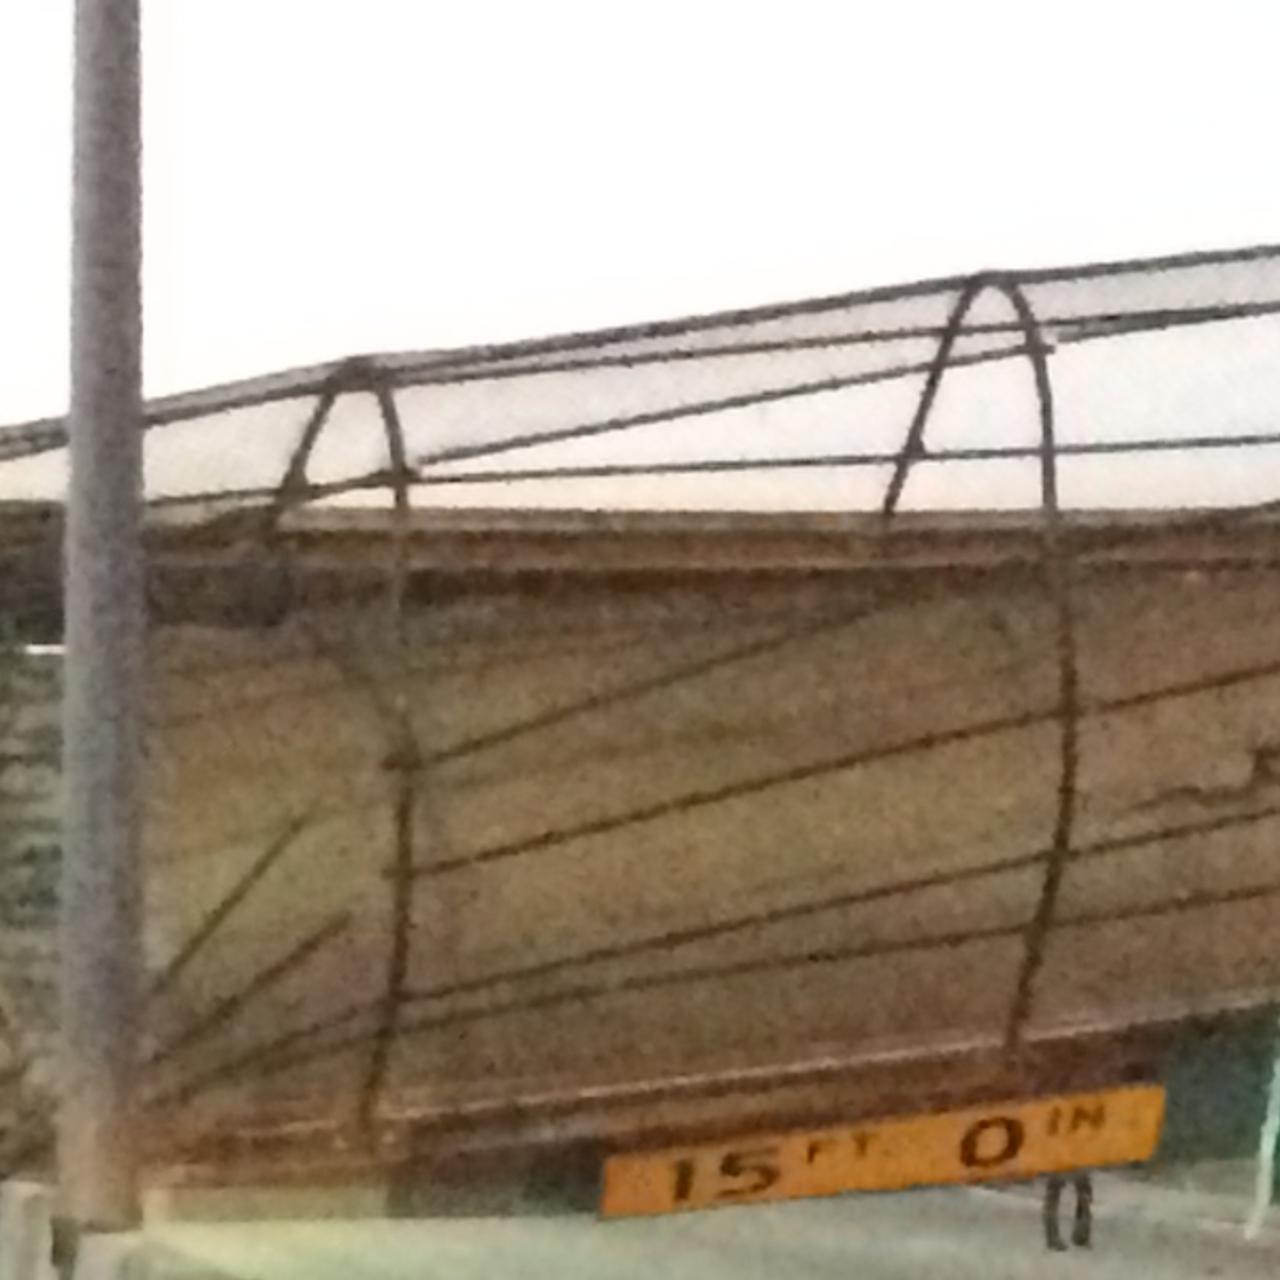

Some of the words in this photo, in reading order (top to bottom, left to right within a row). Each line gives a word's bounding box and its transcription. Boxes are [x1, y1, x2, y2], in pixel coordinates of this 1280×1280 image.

[673, 1146, 781, 1202] 15
[806, 1132, 872, 1164] FT
[960, 1117, 1024, 1167] 0
[1048, 1105, 1106, 1133] IN
